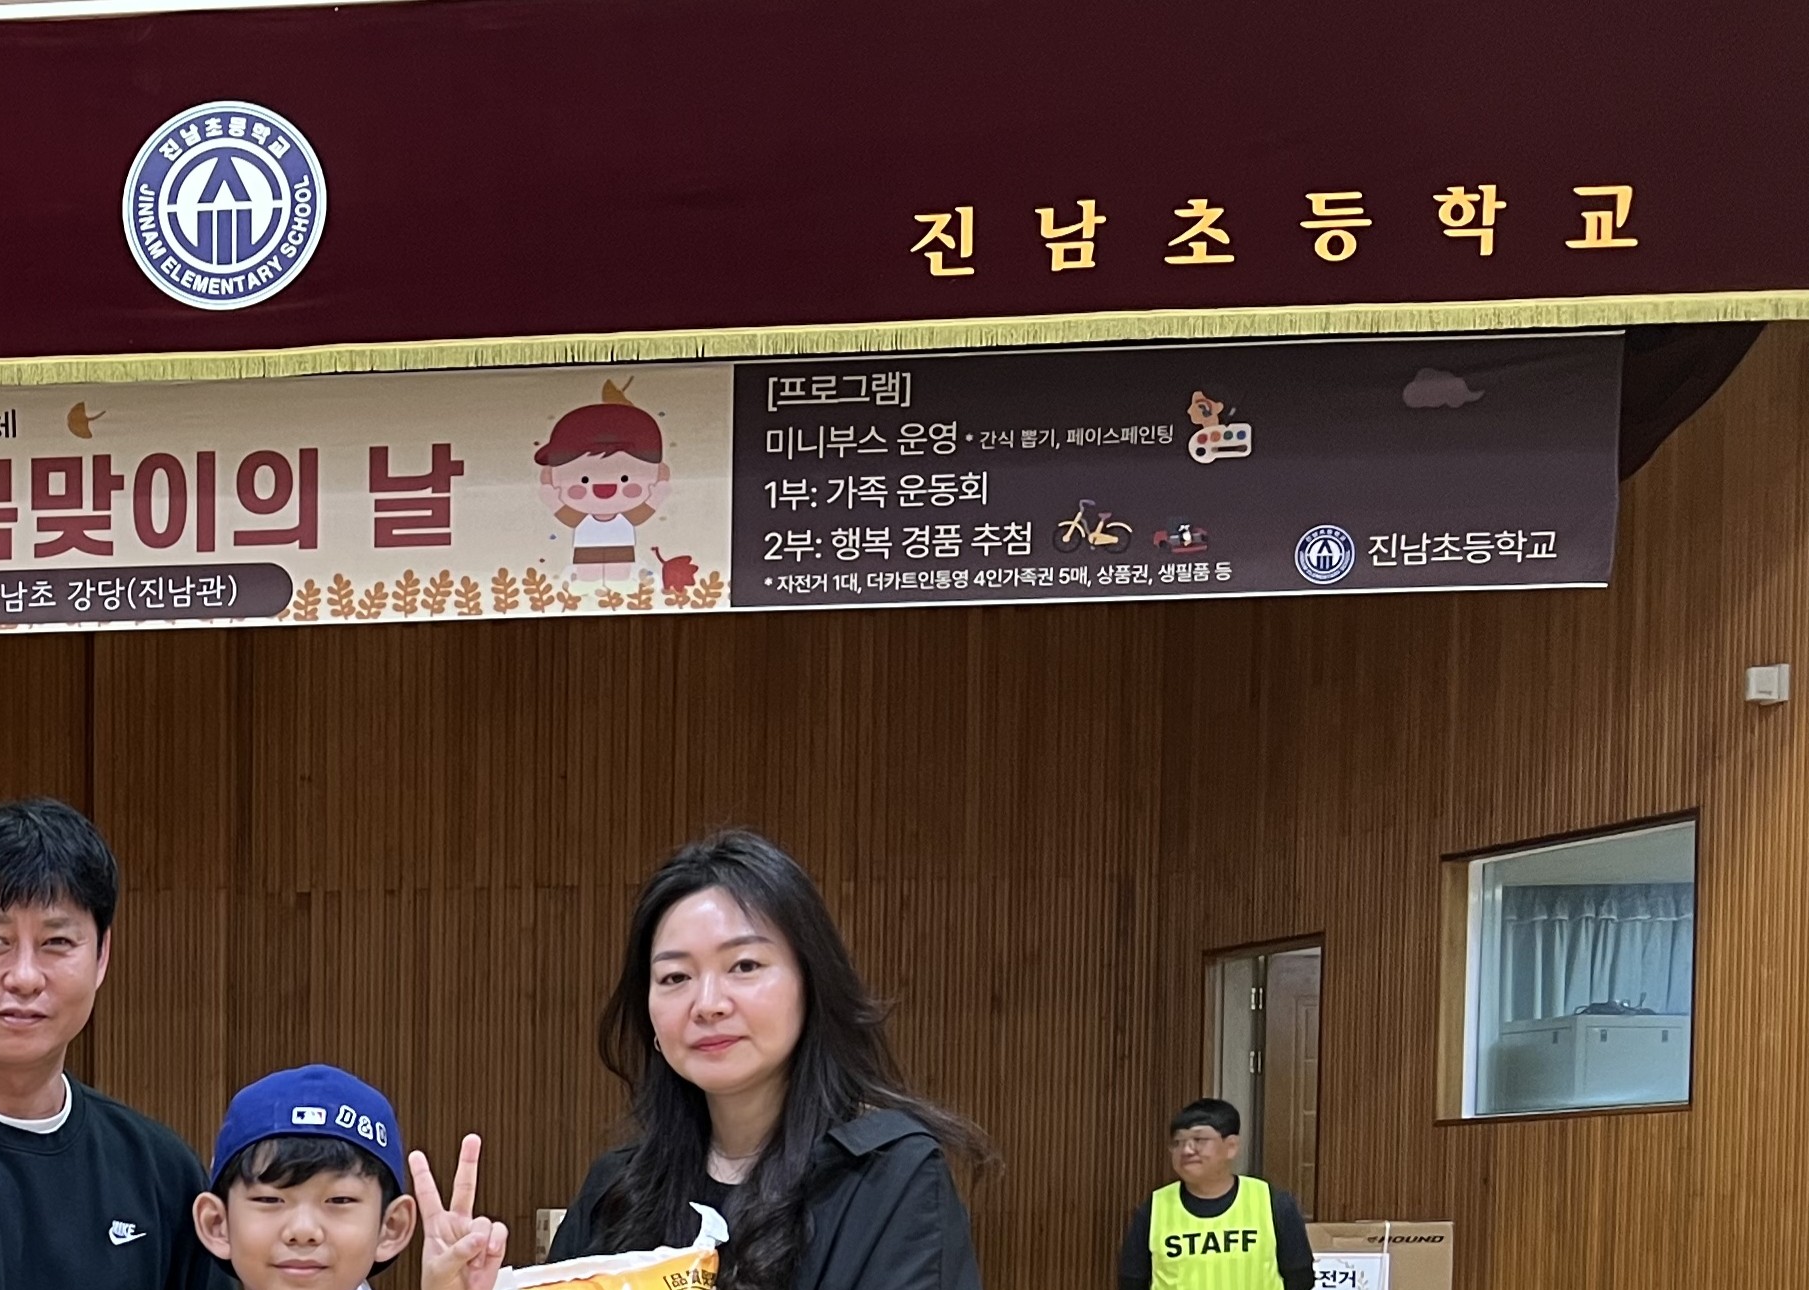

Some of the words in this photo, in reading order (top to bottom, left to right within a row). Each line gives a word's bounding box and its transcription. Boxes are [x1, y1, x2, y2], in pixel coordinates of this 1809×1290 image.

[159, 117, 290, 162] 진남초등학교
[138, 184, 166, 260] JINNAM
[160, 256, 283, 295] ELEMENTARY
[280, 175, 312, 258] SCHOOL
[767, 372, 911, 411] [프로그램]
[766, 424, 888, 460] 미니부스
[897, 421, 957, 456] 운영
[980, 430, 1014, 449] 간식
[1021, 429, 1060, 449] 뽑기,
[1067, 425, 1173, 446] 페이스페인팅
[368, 443, 464, 550] 날
[764, 479, 817, 511] 1부:
[827, 476, 888, 509] 가족
[896, 471, 988, 508] 운동회
[764, 529, 822, 561] 2부:
[831, 526, 892, 560] 행복
[901, 524, 963, 559] 경품
[971, 521, 1032, 556] 추첨
[1367, 530, 1558, 567] 진남초등학교
[67, 574, 238, 612] 강당(진남관)
[777, 573, 828, 593] 자전거
[833, 572, 862, 594] 1대,
[867, 569, 968, 591] 더카트인통영
[973, 567, 1054, 588] 4인가족권
[1059, 565, 1091, 587] 5매,
[1097, 564, 1153, 585] 상품권,
[1158, 562, 1210, 583] 생필품
[1214, 561, 1232, 581] 등
[1164, 1230, 1258, 1258] STAFF
[1314, 1270, 1356, 1288] 전거
